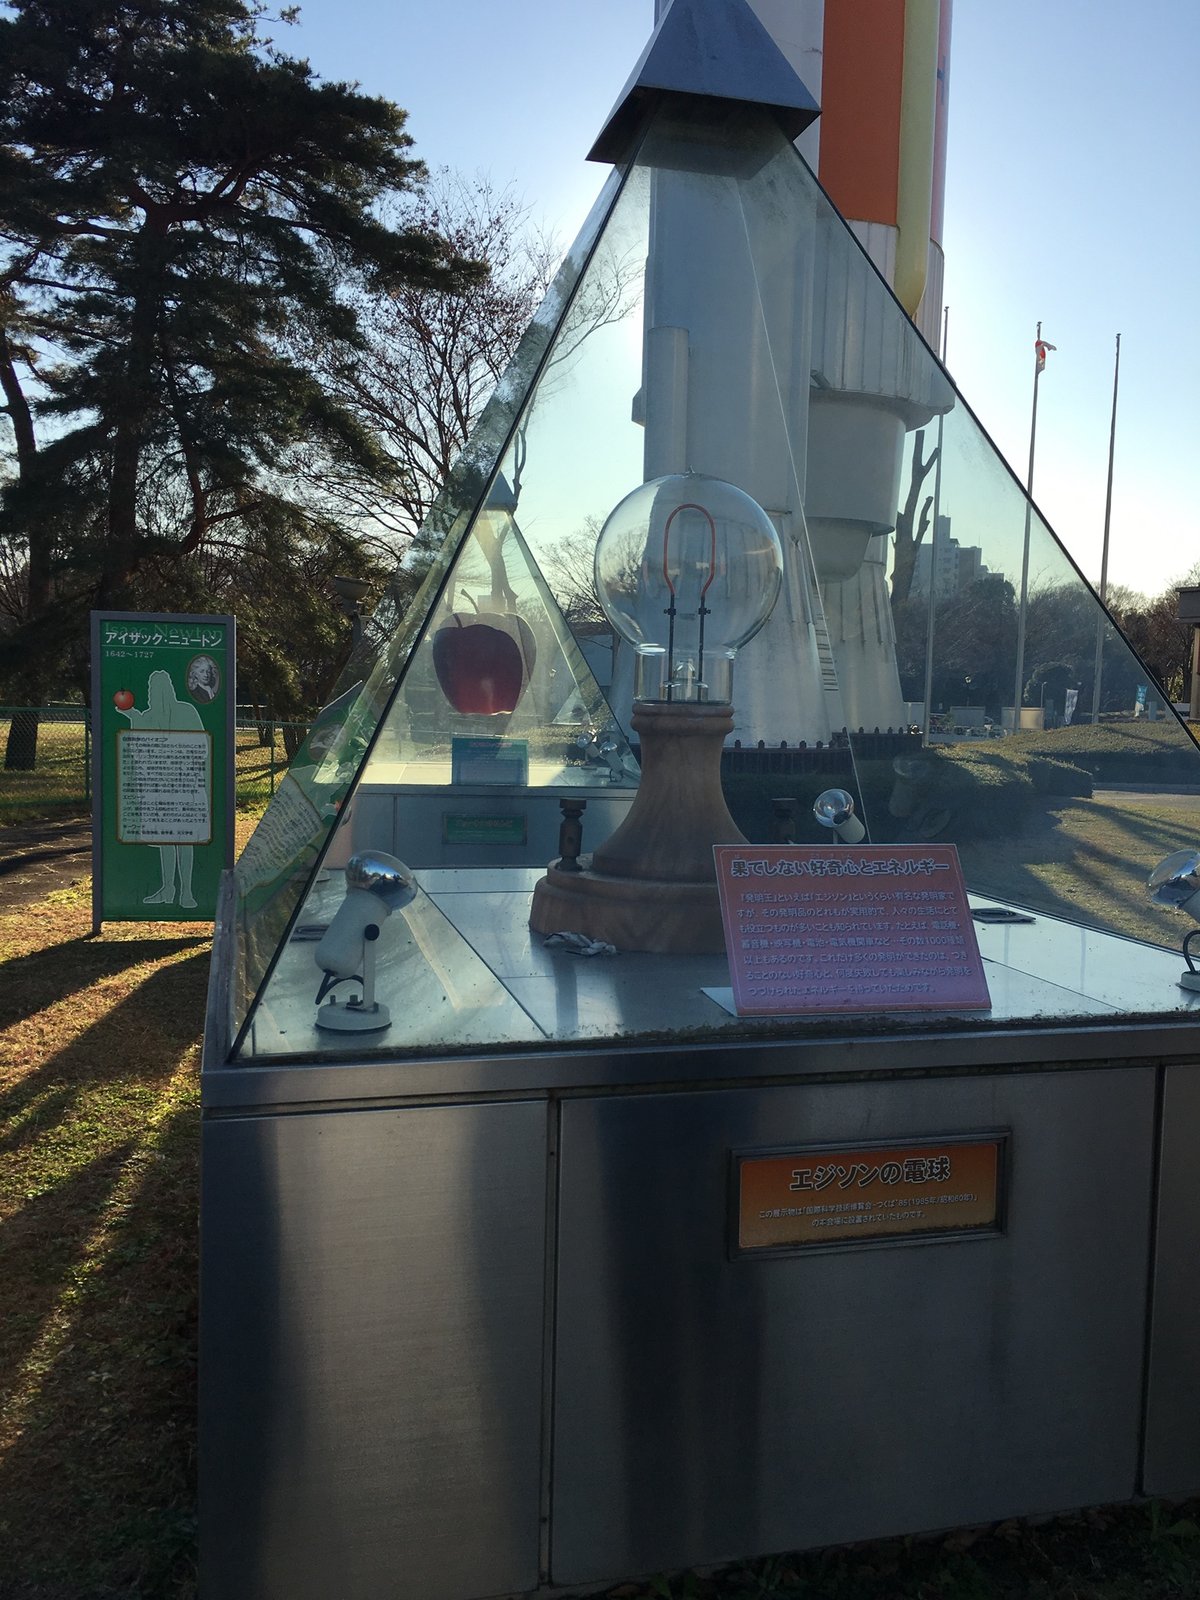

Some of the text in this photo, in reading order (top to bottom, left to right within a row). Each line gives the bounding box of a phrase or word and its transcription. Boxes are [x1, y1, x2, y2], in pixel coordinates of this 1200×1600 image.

[105, 623, 223, 638] Isaac Newton
[105, 631, 222, 647] アイザック・ニュートン
[731, 858, 949, 877] 果てしない好奇心とエネルギー
[789, 1155, 951, 1191] エジソンの電球
